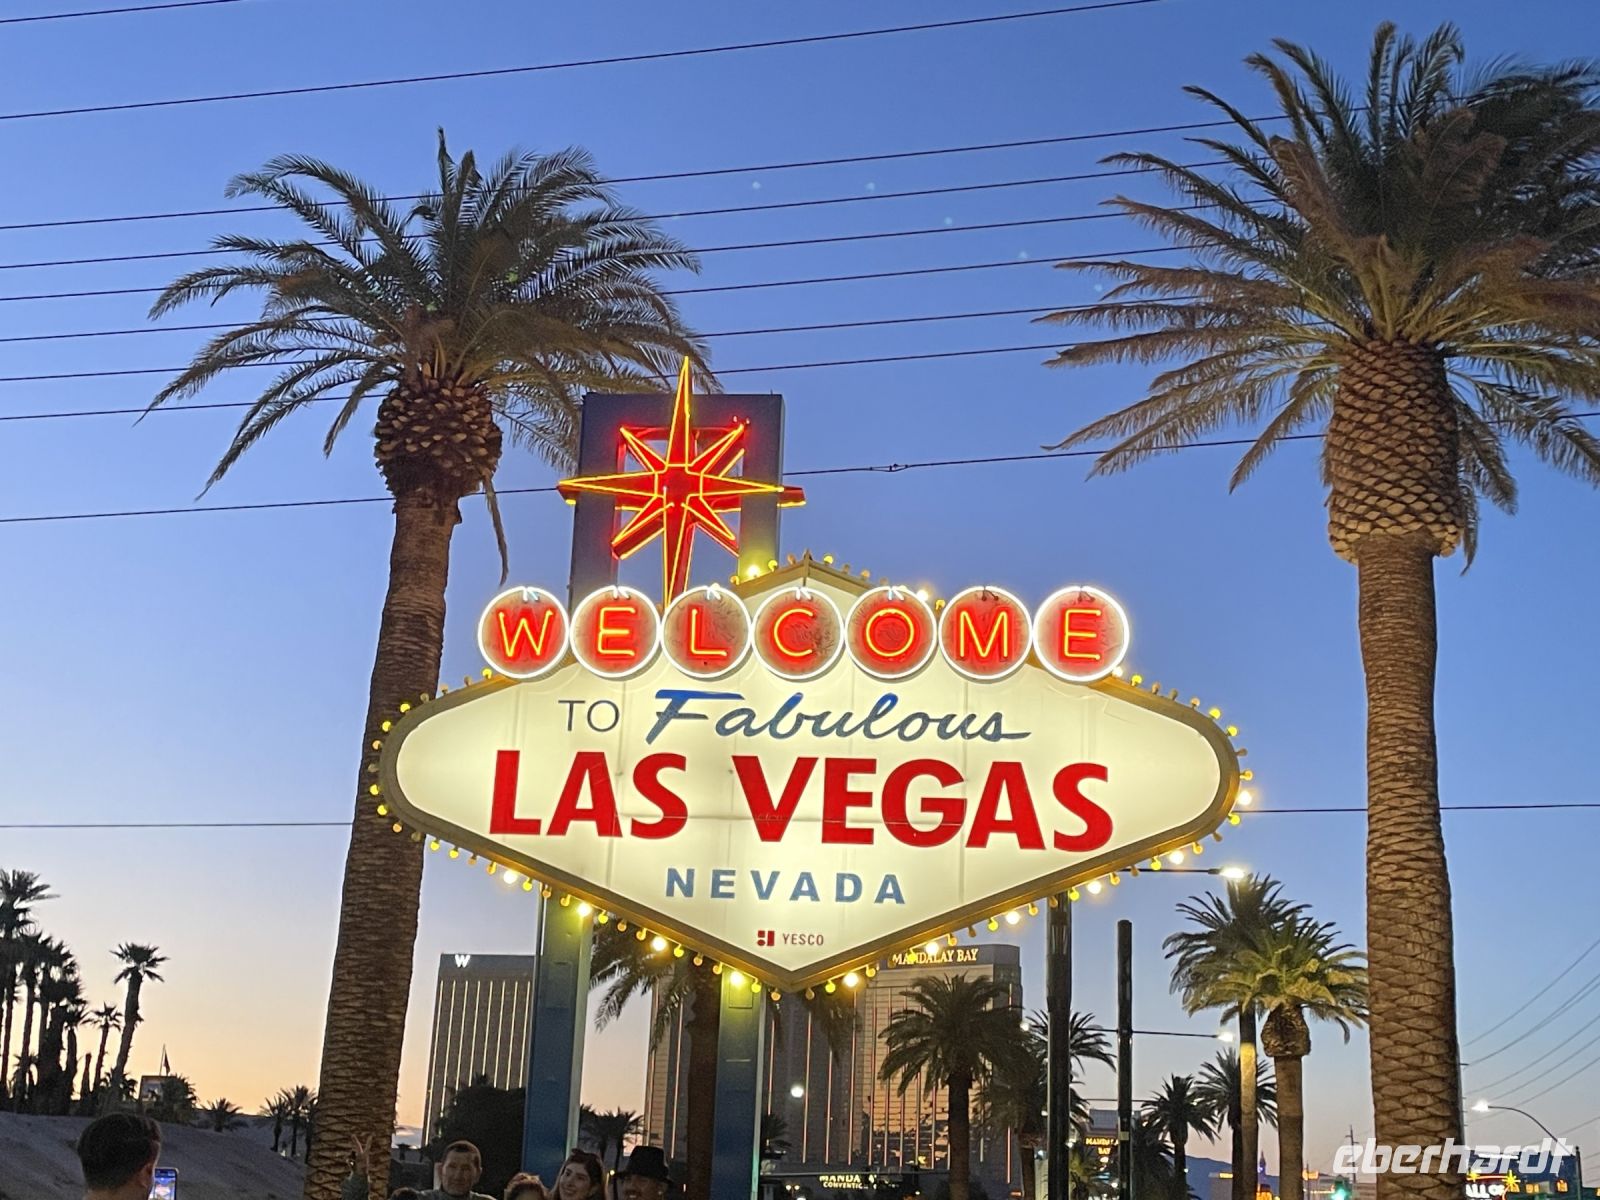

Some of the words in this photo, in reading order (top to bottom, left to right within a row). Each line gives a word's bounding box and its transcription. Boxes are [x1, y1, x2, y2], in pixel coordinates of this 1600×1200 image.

[498, 606, 1102, 660] WELCOME
[558, 700, 619, 732] TO
[646, 690, 1031, 744] Fabulous
[489, 749, 687, 840] LAS
[731, 755, 1114, 852] VEGAS
[666, 867, 905, 905] NEVADA
[782, 933, 824, 946] YESCO
[957, 948, 979, 962] BAY
[455, 954, 471, 968] W
